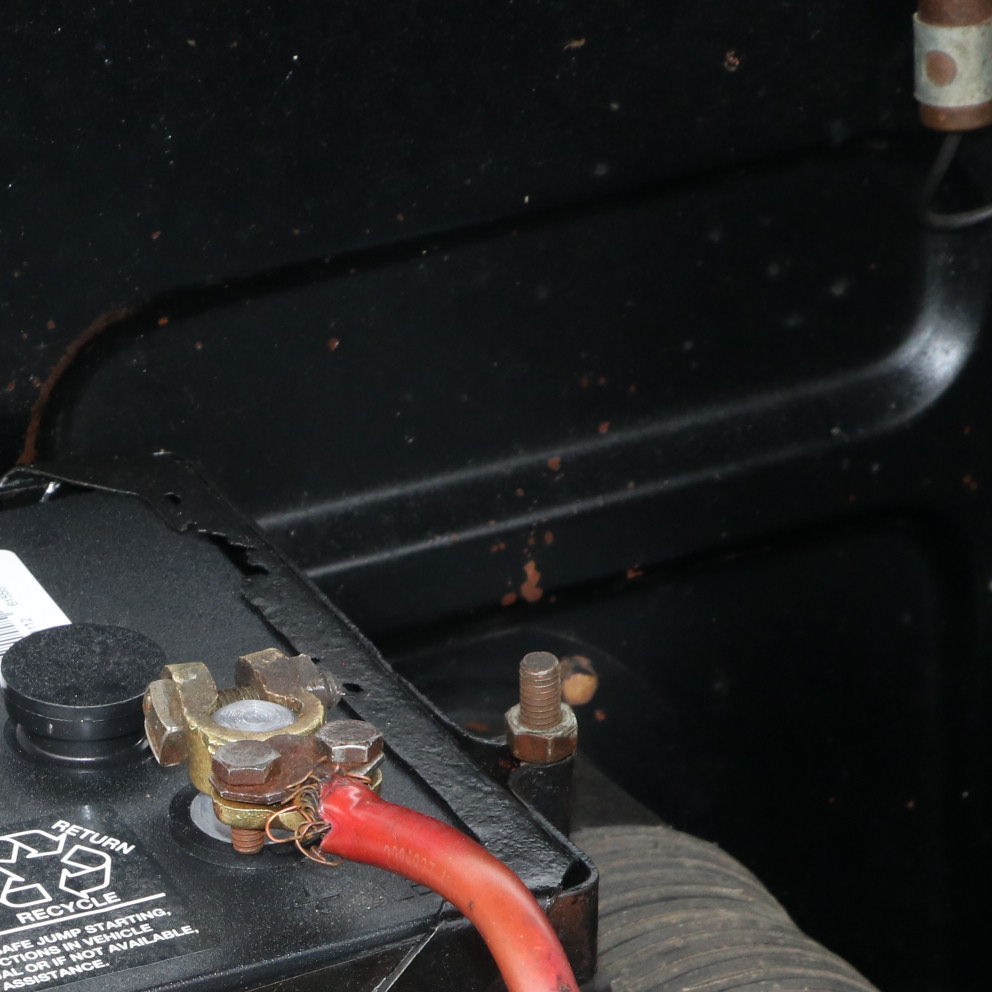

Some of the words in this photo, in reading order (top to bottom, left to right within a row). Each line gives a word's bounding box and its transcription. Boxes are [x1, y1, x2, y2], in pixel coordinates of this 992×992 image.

[51, 820, 135, 854] RETURN
[16, 892, 122, 924] RECYCLE
[36, 928, 82, 946] JUMP
[84, 908, 172, 934] STARTING,
[62, 940, 82, 952] IN
[82, 923, 154, 946] VEHICLE
[24, 960, 51, 974] OR
[52, 956, 67, 967] IF
[70, 947, 104, 962] NOT
[108, 925, 200, 953] AVAILABLE,
[3, 958, 110, 991] ASSISTANCE.
